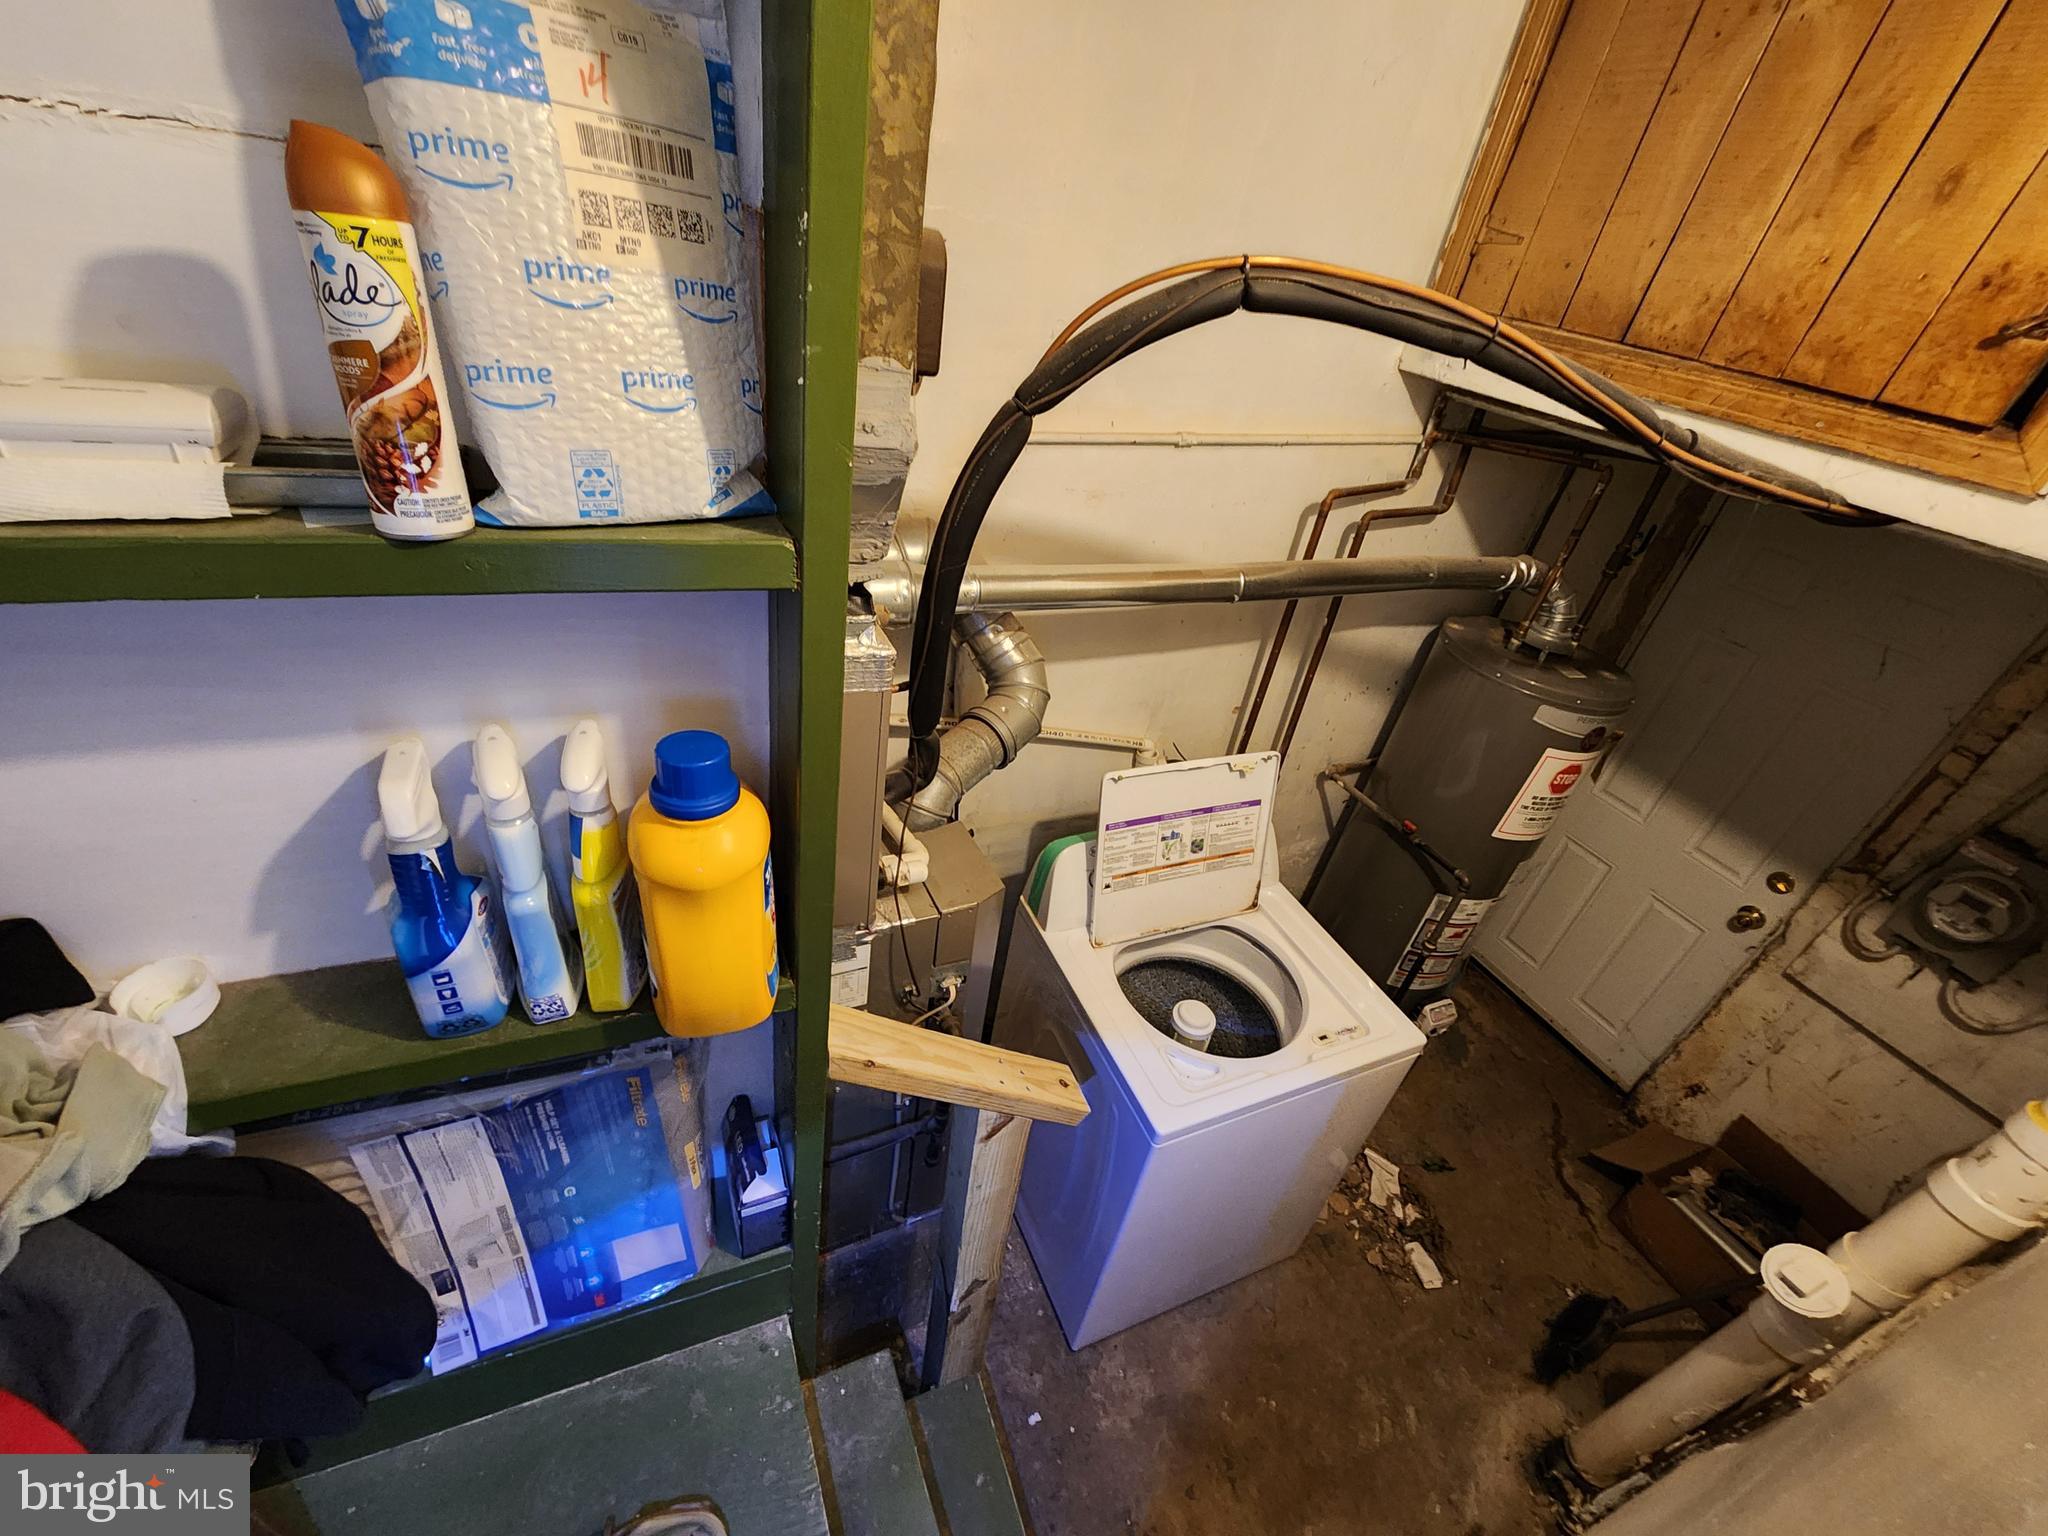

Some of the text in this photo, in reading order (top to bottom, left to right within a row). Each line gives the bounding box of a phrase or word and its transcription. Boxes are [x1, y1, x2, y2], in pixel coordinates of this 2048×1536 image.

[578, 50, 610, 105] 14
[407, 126, 510, 163] prime
[349, 225, 404, 249] 7 HOURS
[524, 256, 612, 286] prime
[673, 276, 737, 304] prime
[465, 359, 552, 388] prime
[622, 365, 694, 390] prime
[1553, 774, 1579, 785] STOP
